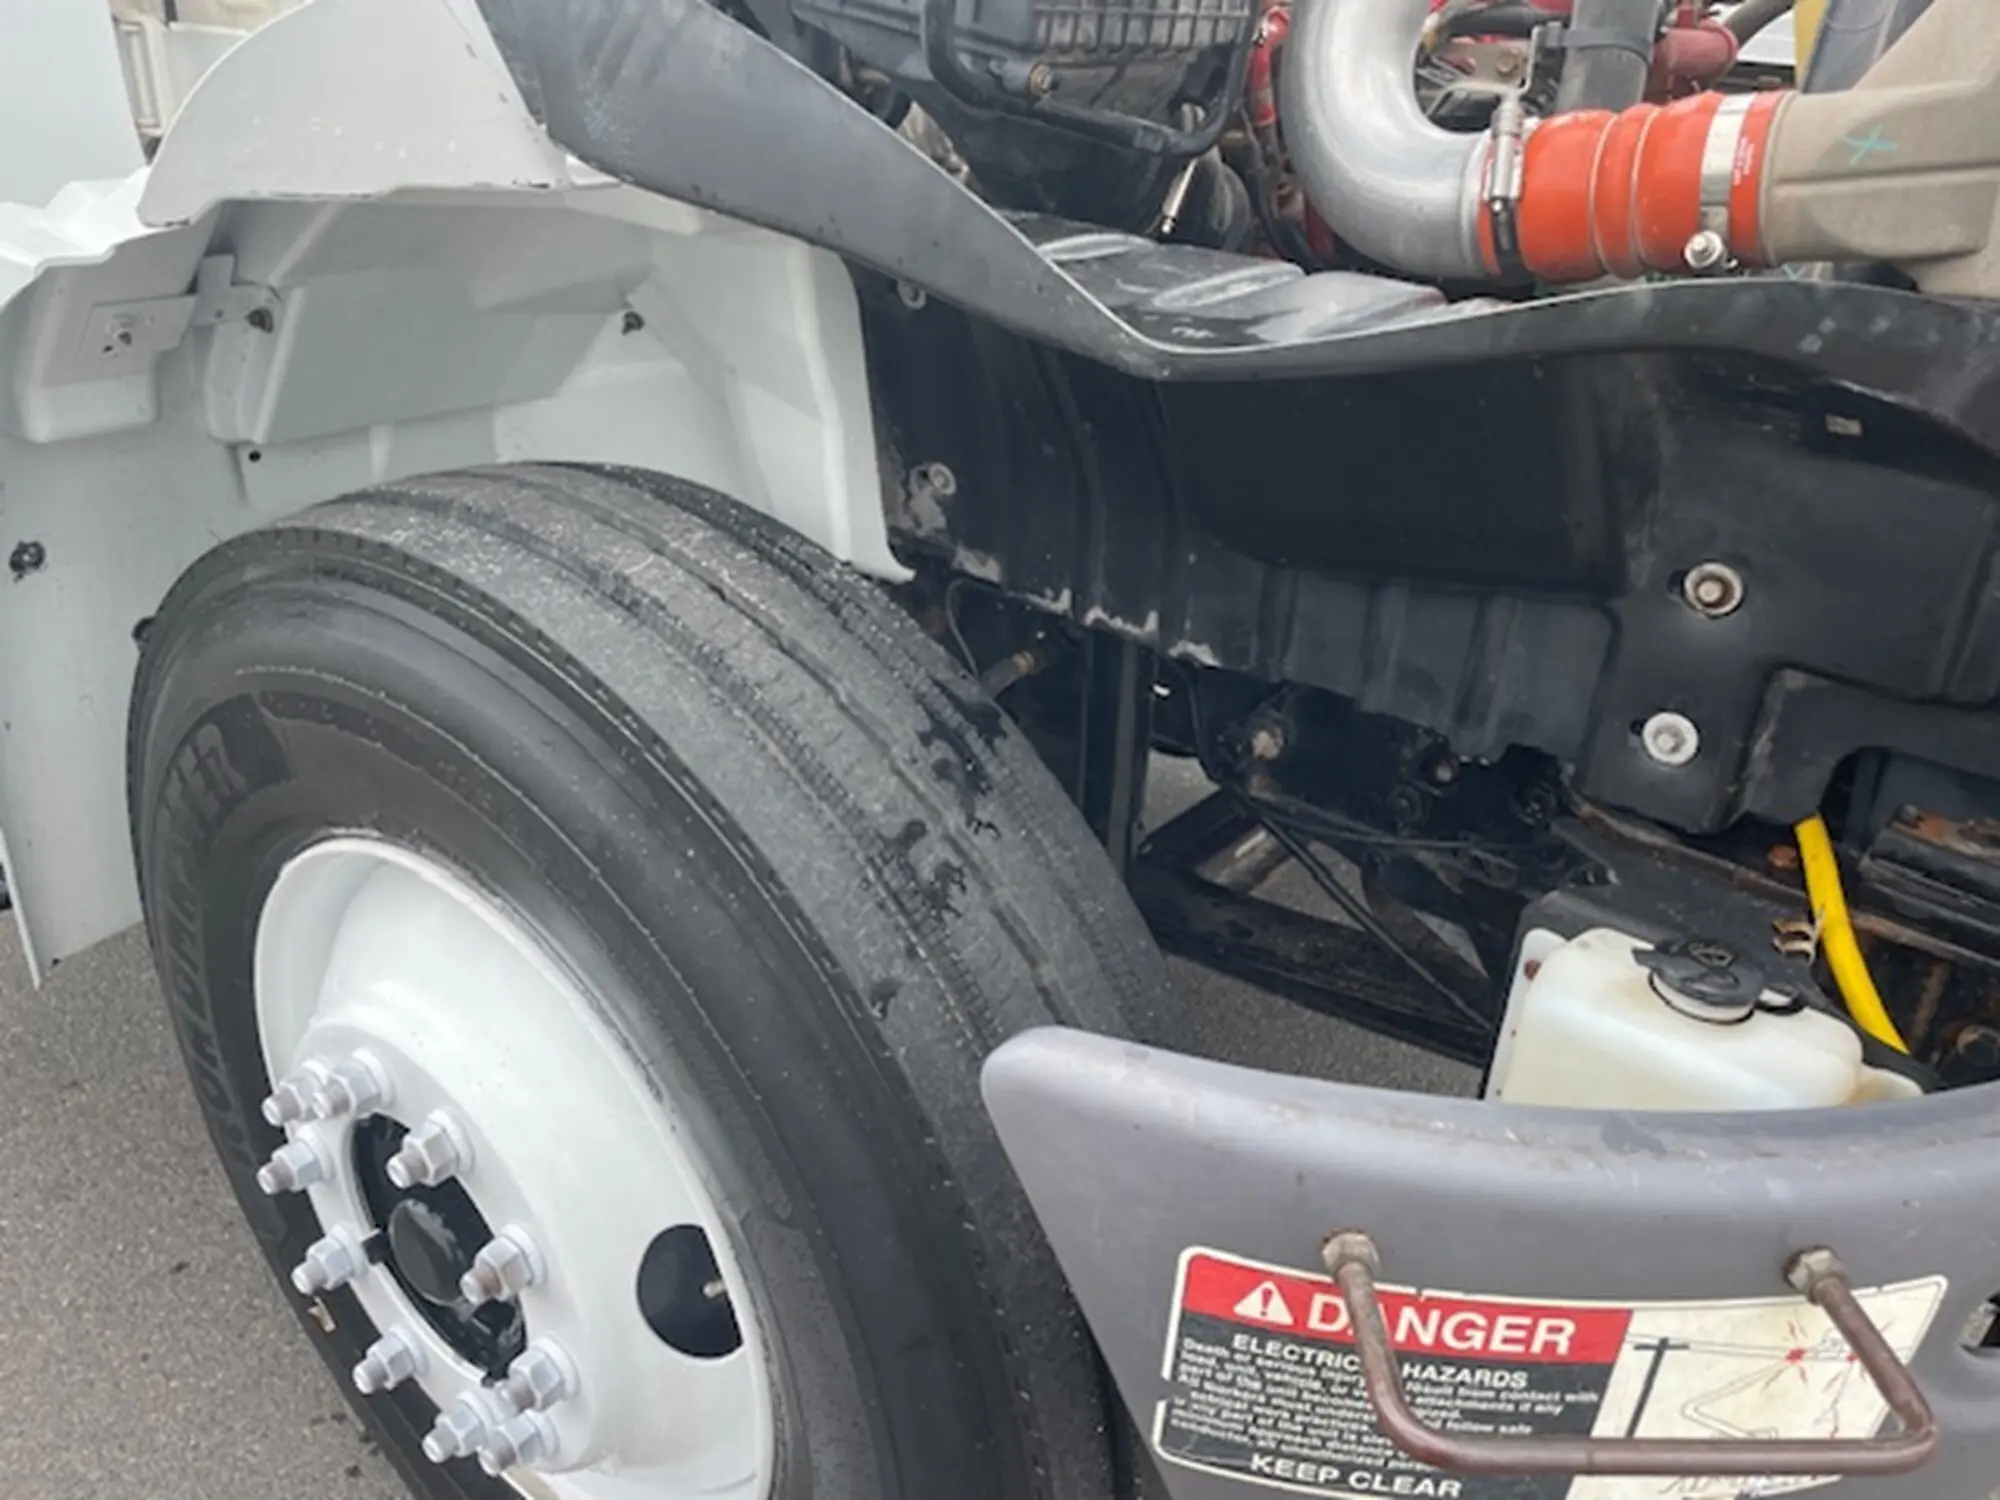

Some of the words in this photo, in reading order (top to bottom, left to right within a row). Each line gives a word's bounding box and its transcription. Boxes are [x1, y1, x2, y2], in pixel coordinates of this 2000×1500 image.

[1307, 1292, 1577, 1356] DNGER
[1183, 1338, 1230, 1357] Death
[1233, 1352, 1251, 1362] or
[1255, 1357, 1317, 1376] serious
[1457, 1386, 1496, 1399] from
[1500, 1390, 1560, 1402] contact
[1564, 1390, 1599, 1403] with
[1233, 1333, 1362, 1373] ELECTRIC
[1402, 1362, 1529, 1389] HAZARDS
[1415, 1396, 1514, 1412] attachments
[1534, 1404, 1564, 1418] any
[1251, 1452, 1341, 1484] KEEP
[1348, 1470, 1463, 1499] CLEAR
